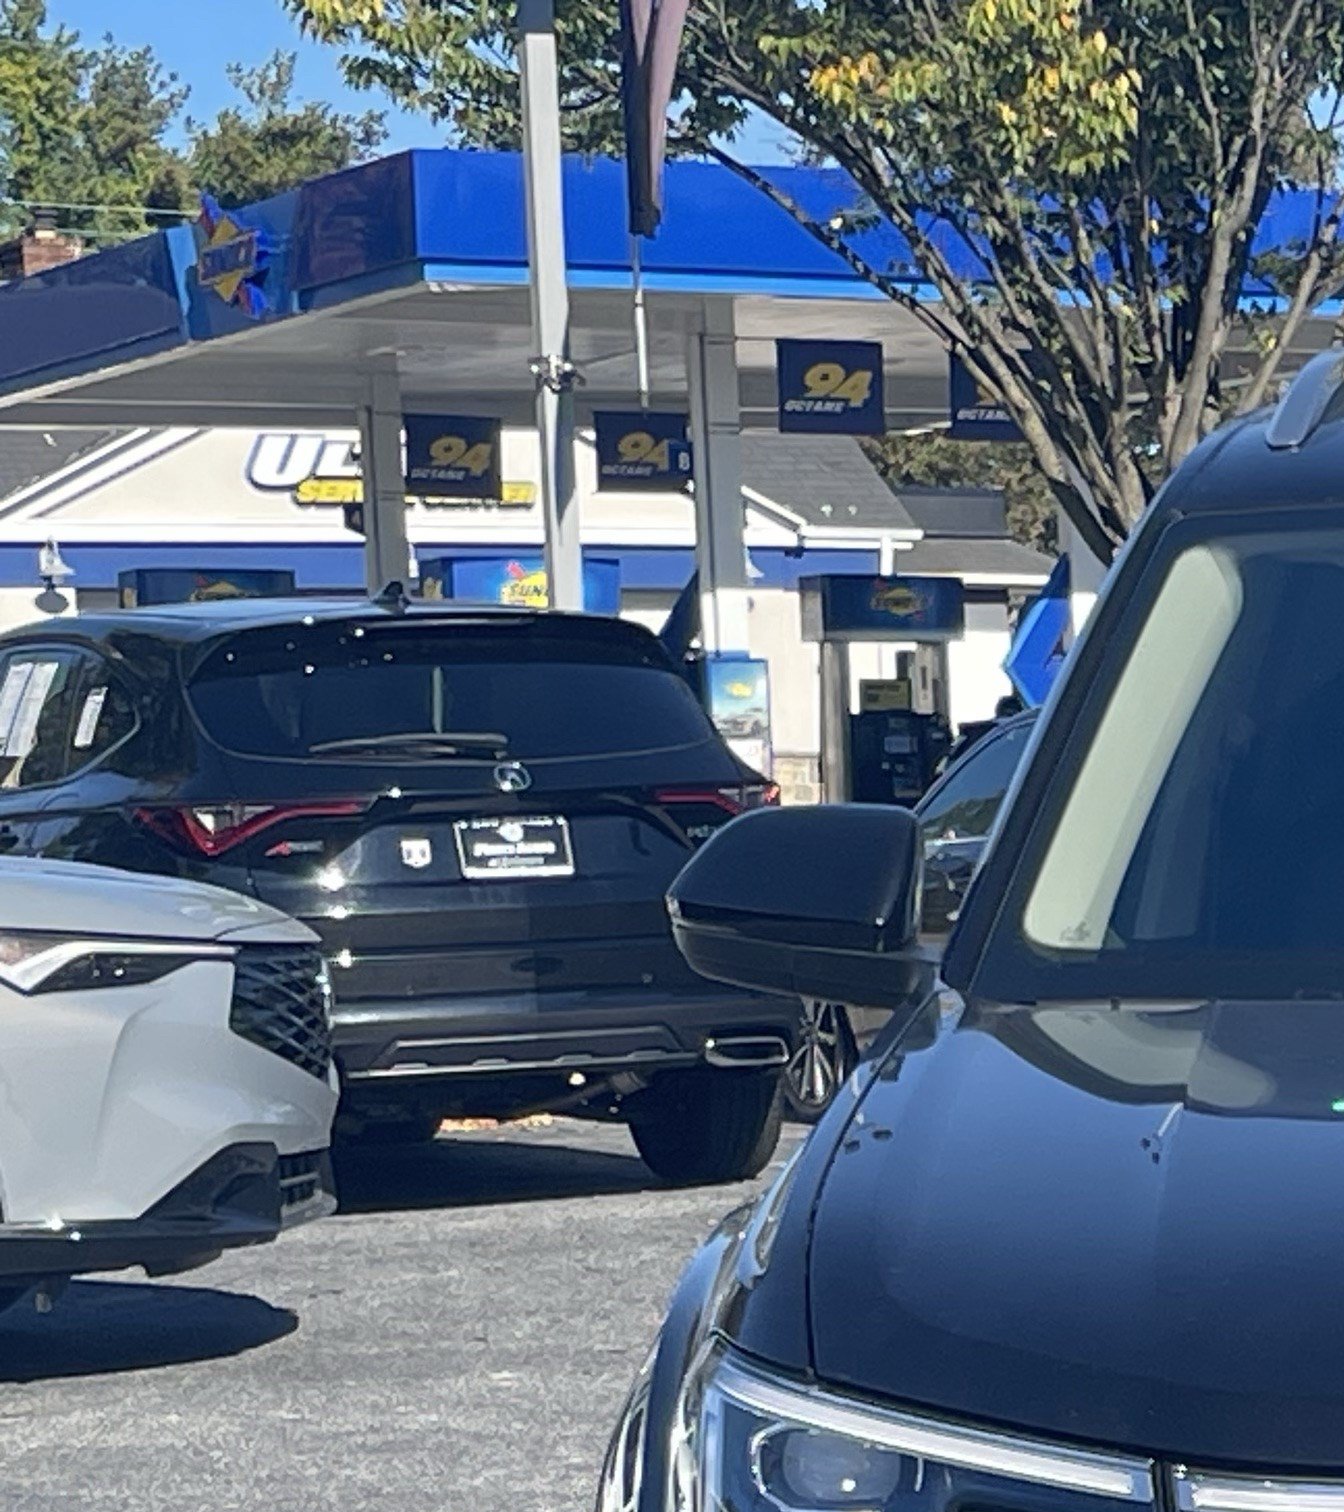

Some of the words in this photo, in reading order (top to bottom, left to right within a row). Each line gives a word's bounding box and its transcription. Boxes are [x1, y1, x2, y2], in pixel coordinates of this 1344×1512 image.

[804, 363, 872, 407] 94
[784, 400, 846, 412] OCTANE
[429, 436, 493, 476] 94
[618, 431, 669, 471] 94
